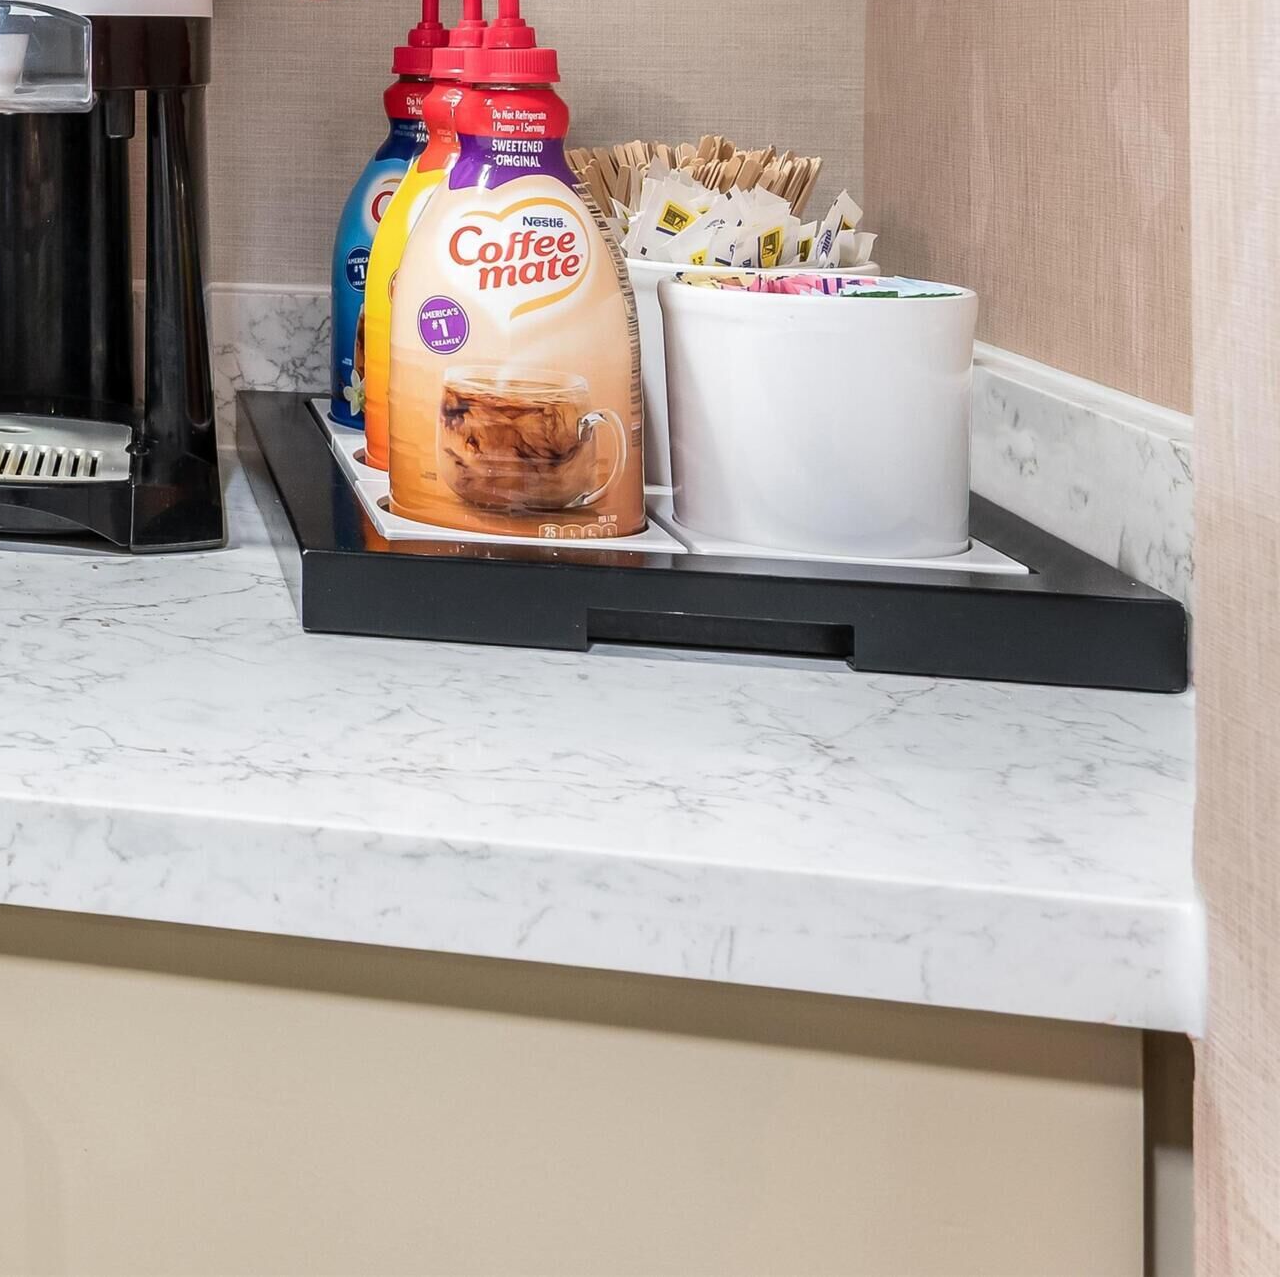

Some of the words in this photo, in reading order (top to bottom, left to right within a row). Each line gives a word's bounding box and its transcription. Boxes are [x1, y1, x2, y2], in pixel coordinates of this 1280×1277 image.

[492, 109, 501, 119] Do
[502, 109, 514, 120] Not
[497, 121, 515, 134] Pump
[525, 123, 546, 135] Serving
[491, 138, 544, 153] SWEETENED
[495, 154, 541, 168] ORIGINAL
[449, 225, 576, 266] Coffee
[479, 253, 580, 291] mate
[421, 307, 459, 320] AMERICA'S
[431, 318, 449, 338] #1
